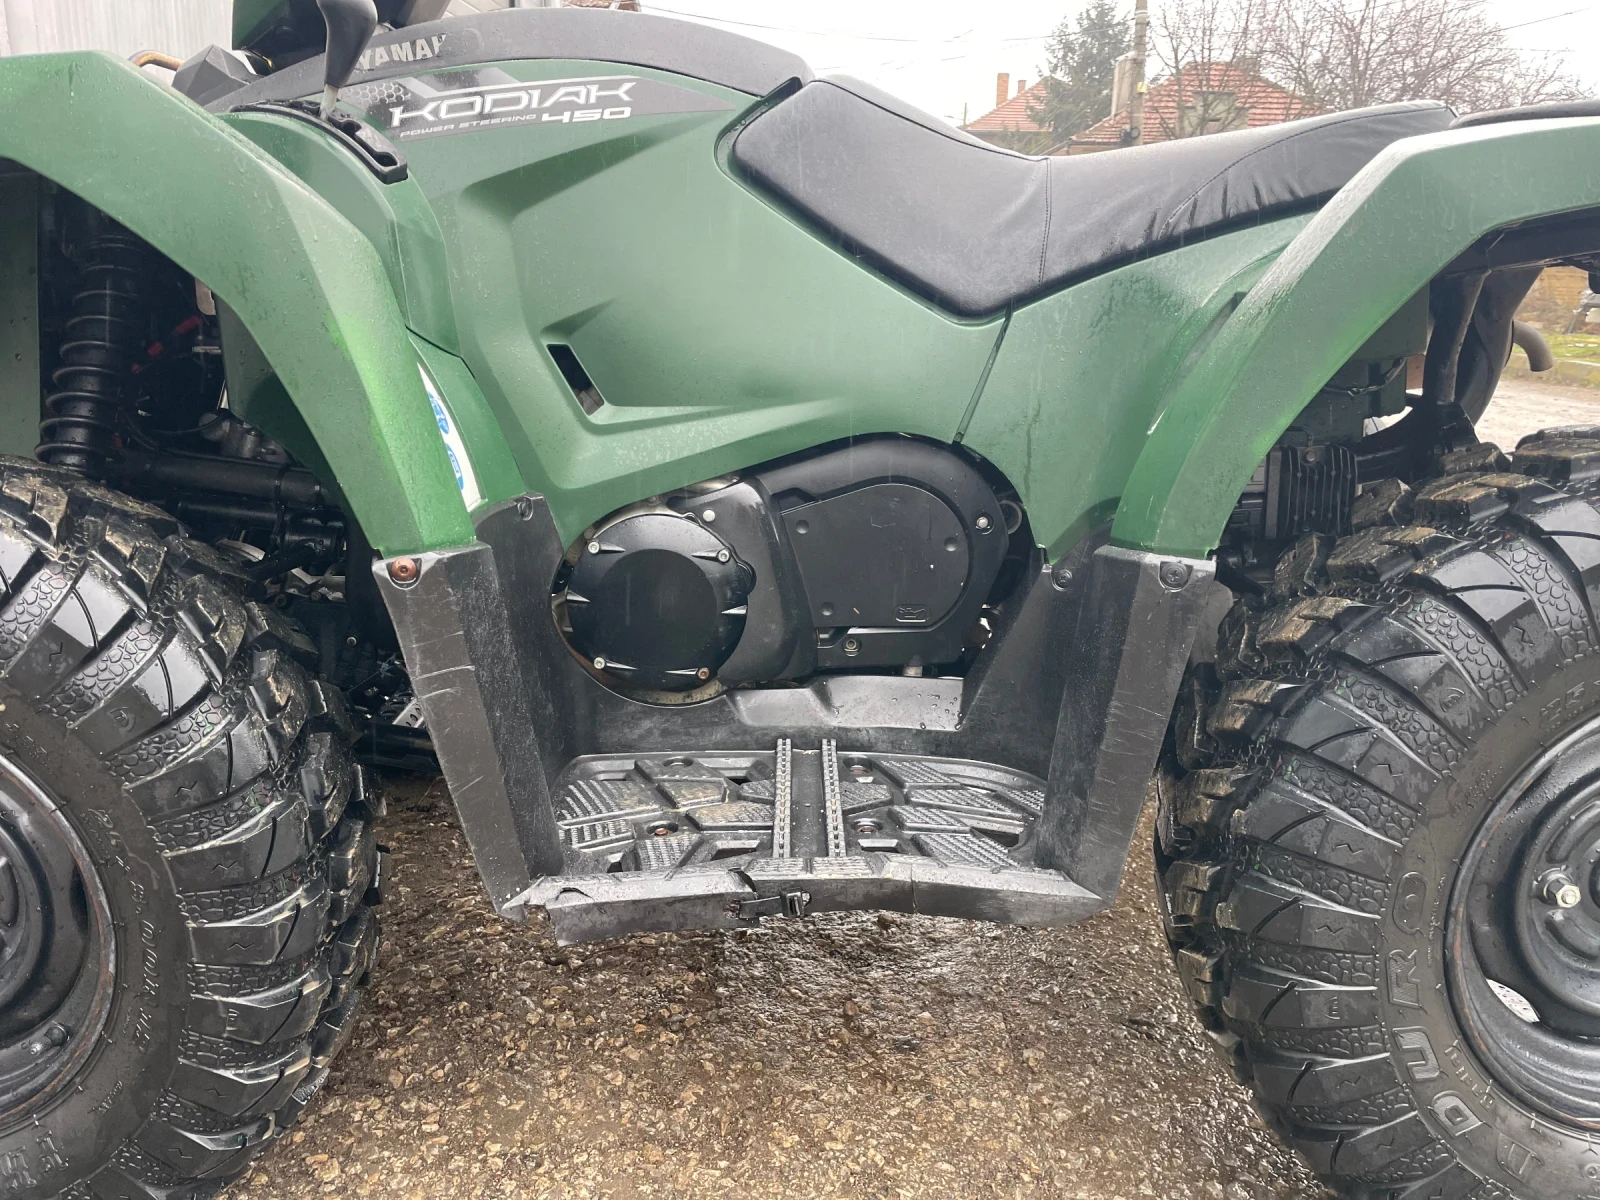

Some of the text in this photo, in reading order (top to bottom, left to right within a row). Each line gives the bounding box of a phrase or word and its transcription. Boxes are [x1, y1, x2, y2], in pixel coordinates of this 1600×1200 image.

[389, 82, 637, 128] KODIAK
[400, 106, 632, 138] POWER STEERING 450
[1385, 870, 1484, 1139] DURO
